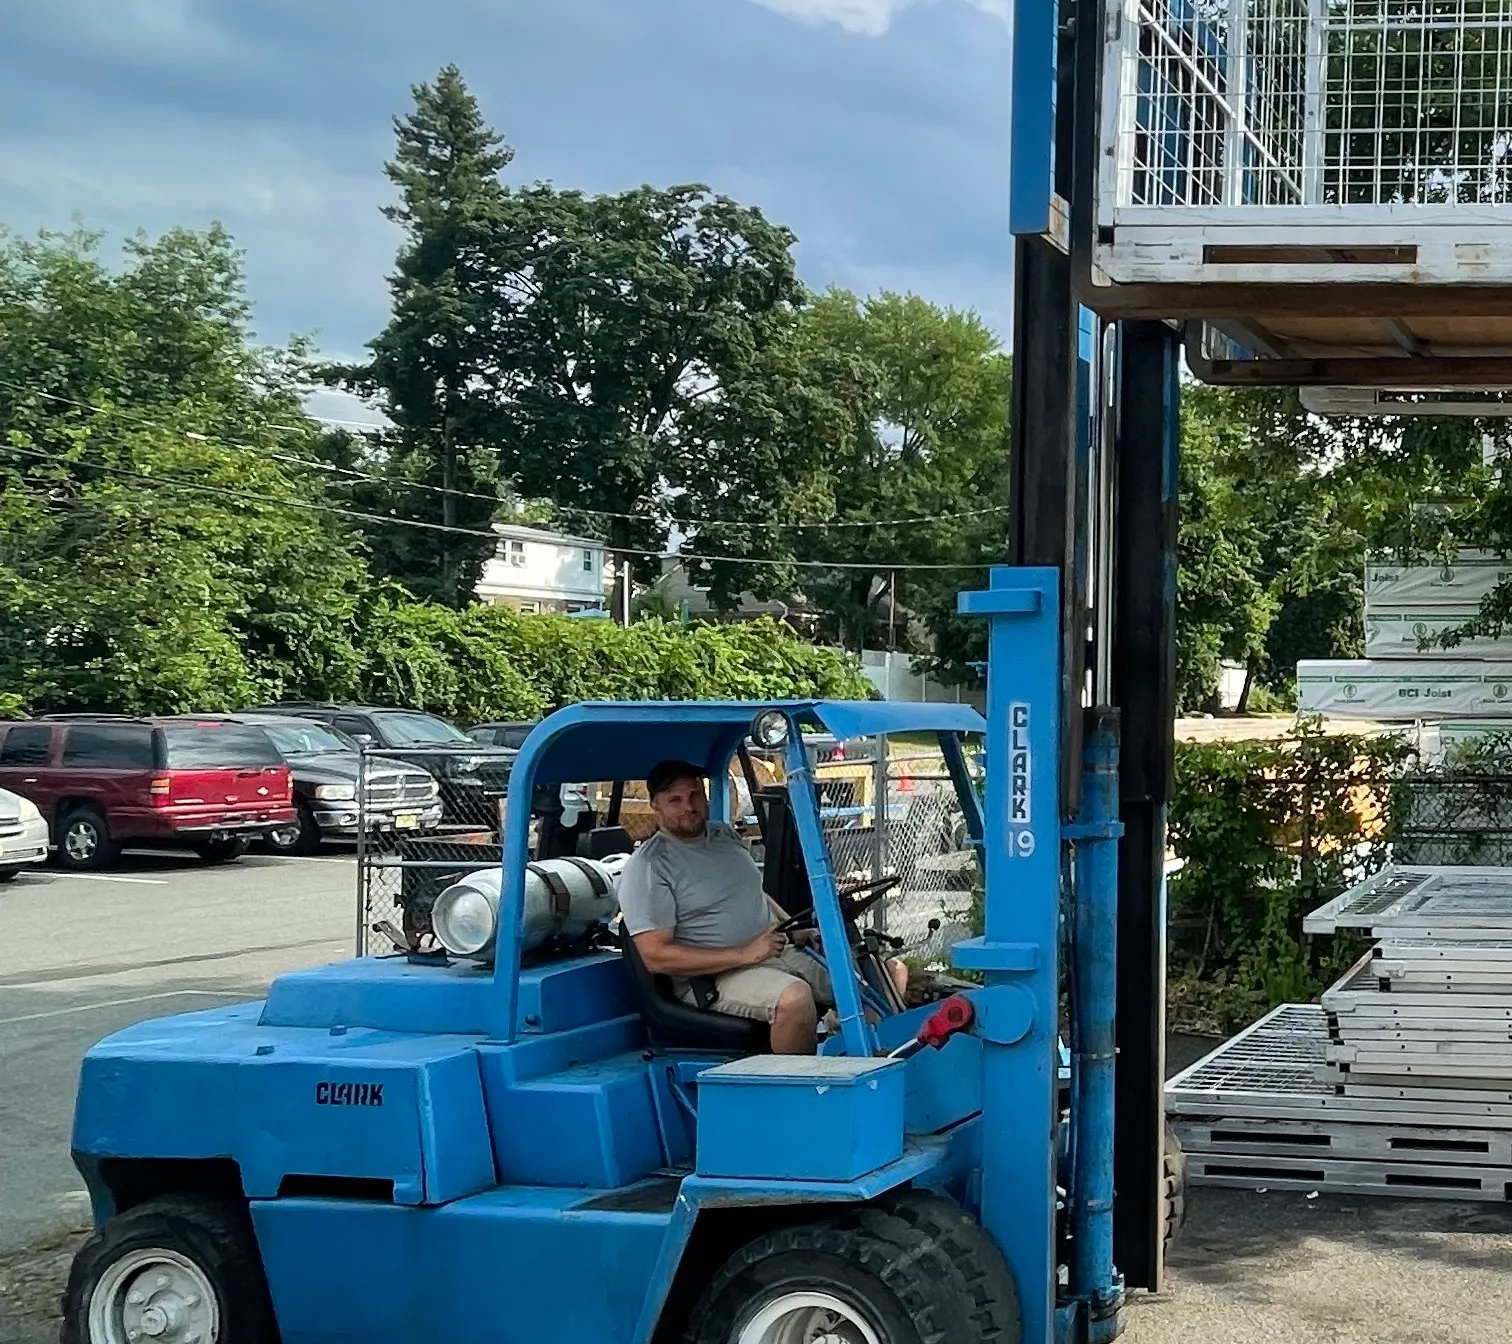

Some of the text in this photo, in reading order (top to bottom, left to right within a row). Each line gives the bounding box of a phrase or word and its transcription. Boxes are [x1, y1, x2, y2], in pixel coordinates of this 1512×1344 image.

[1371, 573, 1399, 582] Joist
[1399, 688, 1452, 698] BCI Joist
[1012, 706, 1028, 819] CLARK
[1008, 830, 1036, 858] 19
[315, 1081, 384, 1106] CLARK
